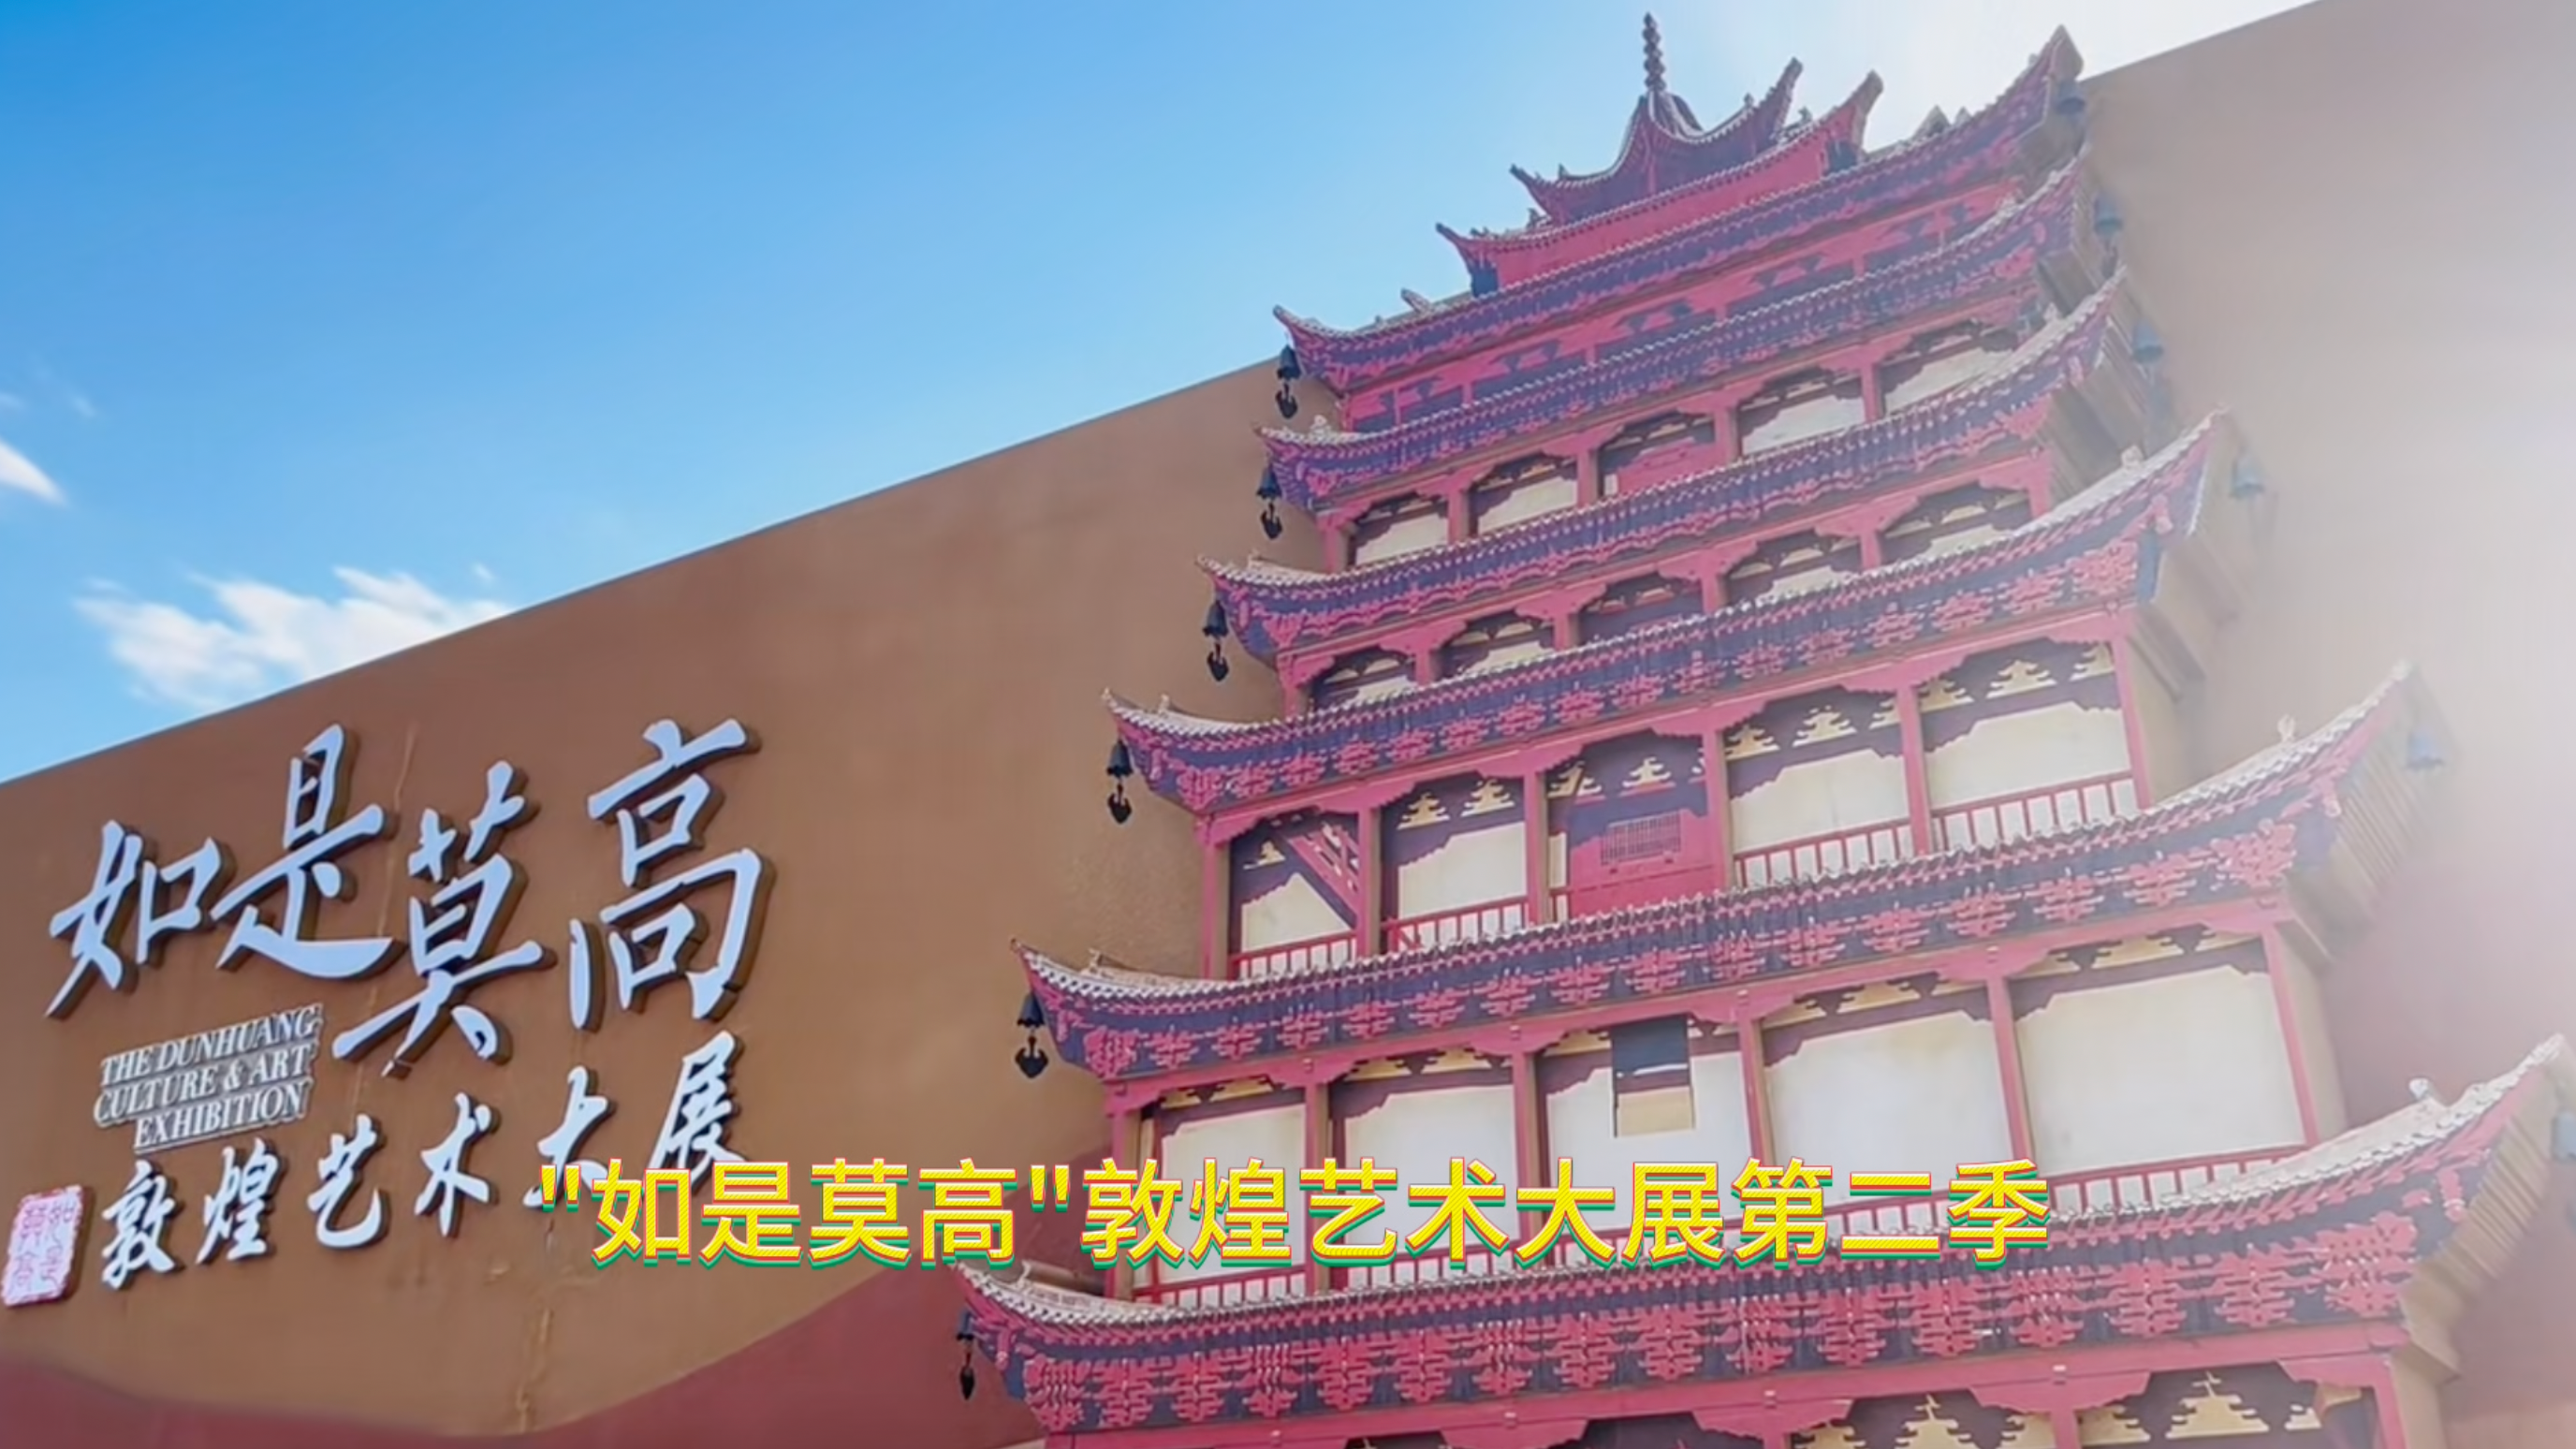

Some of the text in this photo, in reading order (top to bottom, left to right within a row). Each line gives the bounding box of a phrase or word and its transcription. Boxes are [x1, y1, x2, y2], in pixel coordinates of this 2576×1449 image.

[45, 719, 764, 1078] 如是莫高
[94, 1044, 313, 1122] CULTURE & ART
[100, 1005, 319, 1086] THE DUNHUANG
[134, 1080, 310, 1149] EXHIBITION
[100, 1030, 750, 1290] 敦煌艺术大展
